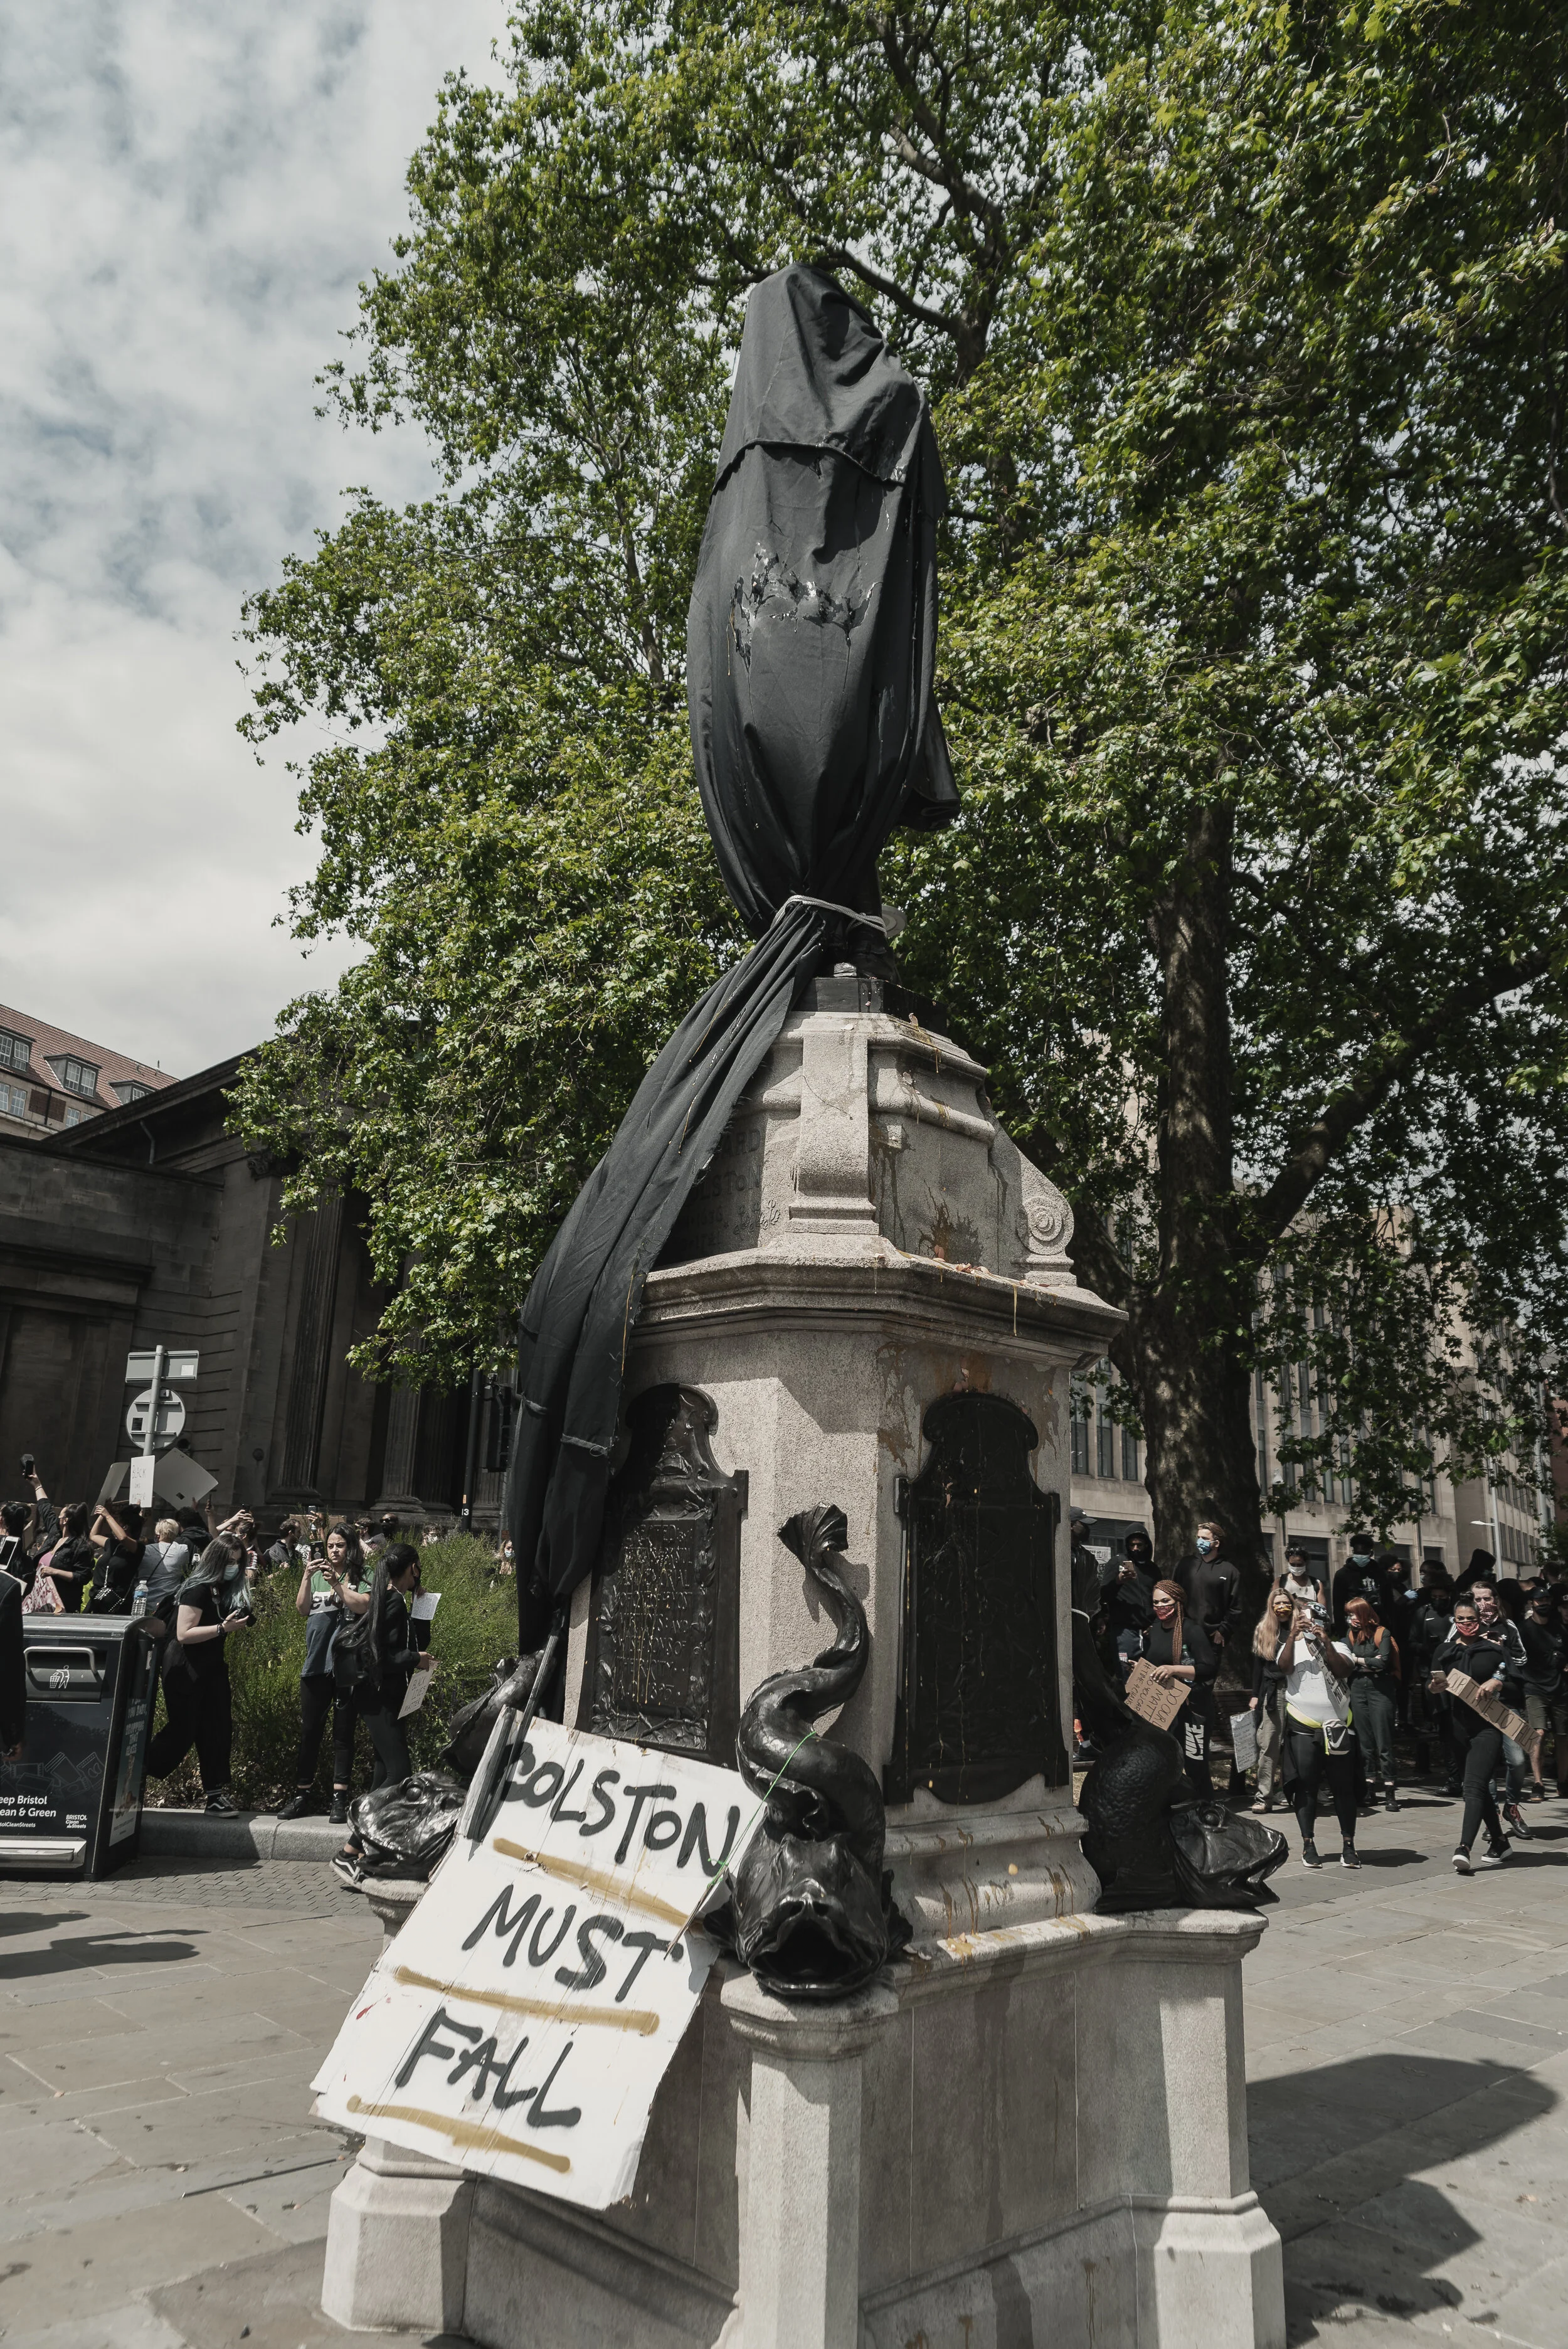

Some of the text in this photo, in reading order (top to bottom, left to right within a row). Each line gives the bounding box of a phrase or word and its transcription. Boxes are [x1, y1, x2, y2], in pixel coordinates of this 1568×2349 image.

[721, 1129, 761, 1158] ARD
[462, 1508, 469, 1516] 13
[1144, 1689, 1163, 1721] MATT
[1185, 1722, 1204, 1760] NIKE
[1495, 1705, 1515, 1729] TO
[1512, 1719, 1539, 1752] TALK
[0, 1795, 48, 1806] eep Bristol
[0, 1807, 56, 1818] ean & Green
[500, 1741, 741, 1877] COLSTON
[462, 1884, 684, 2003] MUST
[396, 2007, 582, 2128] FALL
